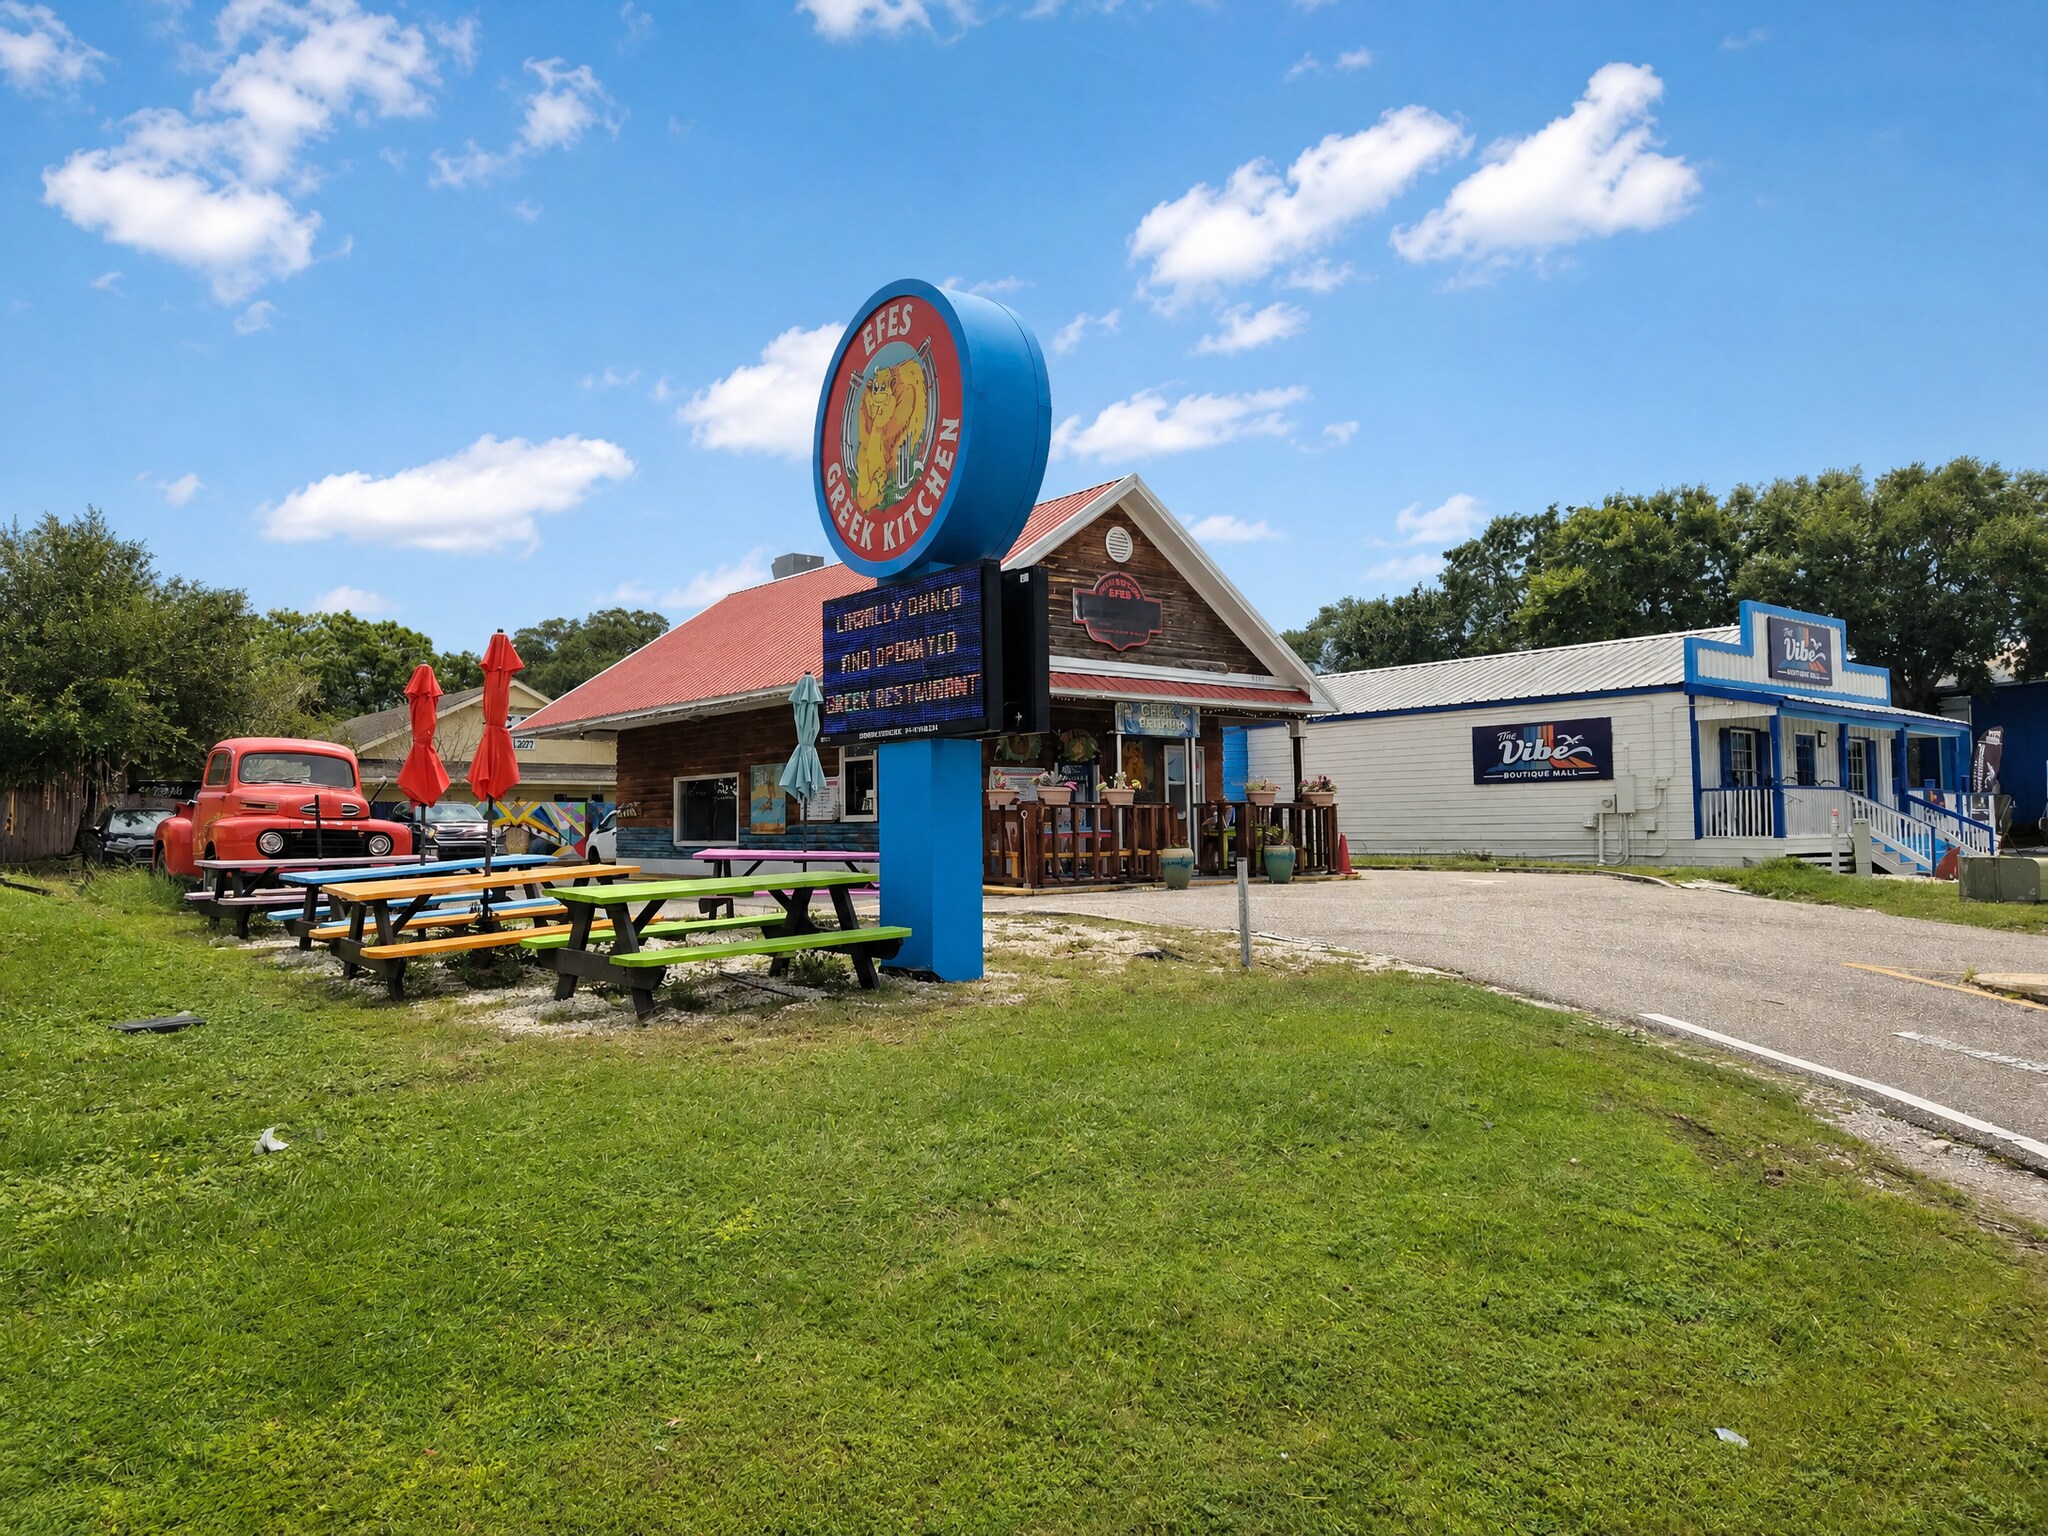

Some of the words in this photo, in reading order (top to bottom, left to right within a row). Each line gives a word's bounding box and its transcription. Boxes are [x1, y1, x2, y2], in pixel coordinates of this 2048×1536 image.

[862, 303, 914, 356] EFES
[826, 462, 874, 552] GREEK
[883, 417, 961, 553] KITCHEN
[1783, 637, 1826, 663] Vibe
[1498, 738, 1592, 766] Vibe
[1503, 770, 1550, 780] BOUTIQUE
[1552, 769, 1579, 777] MALL
